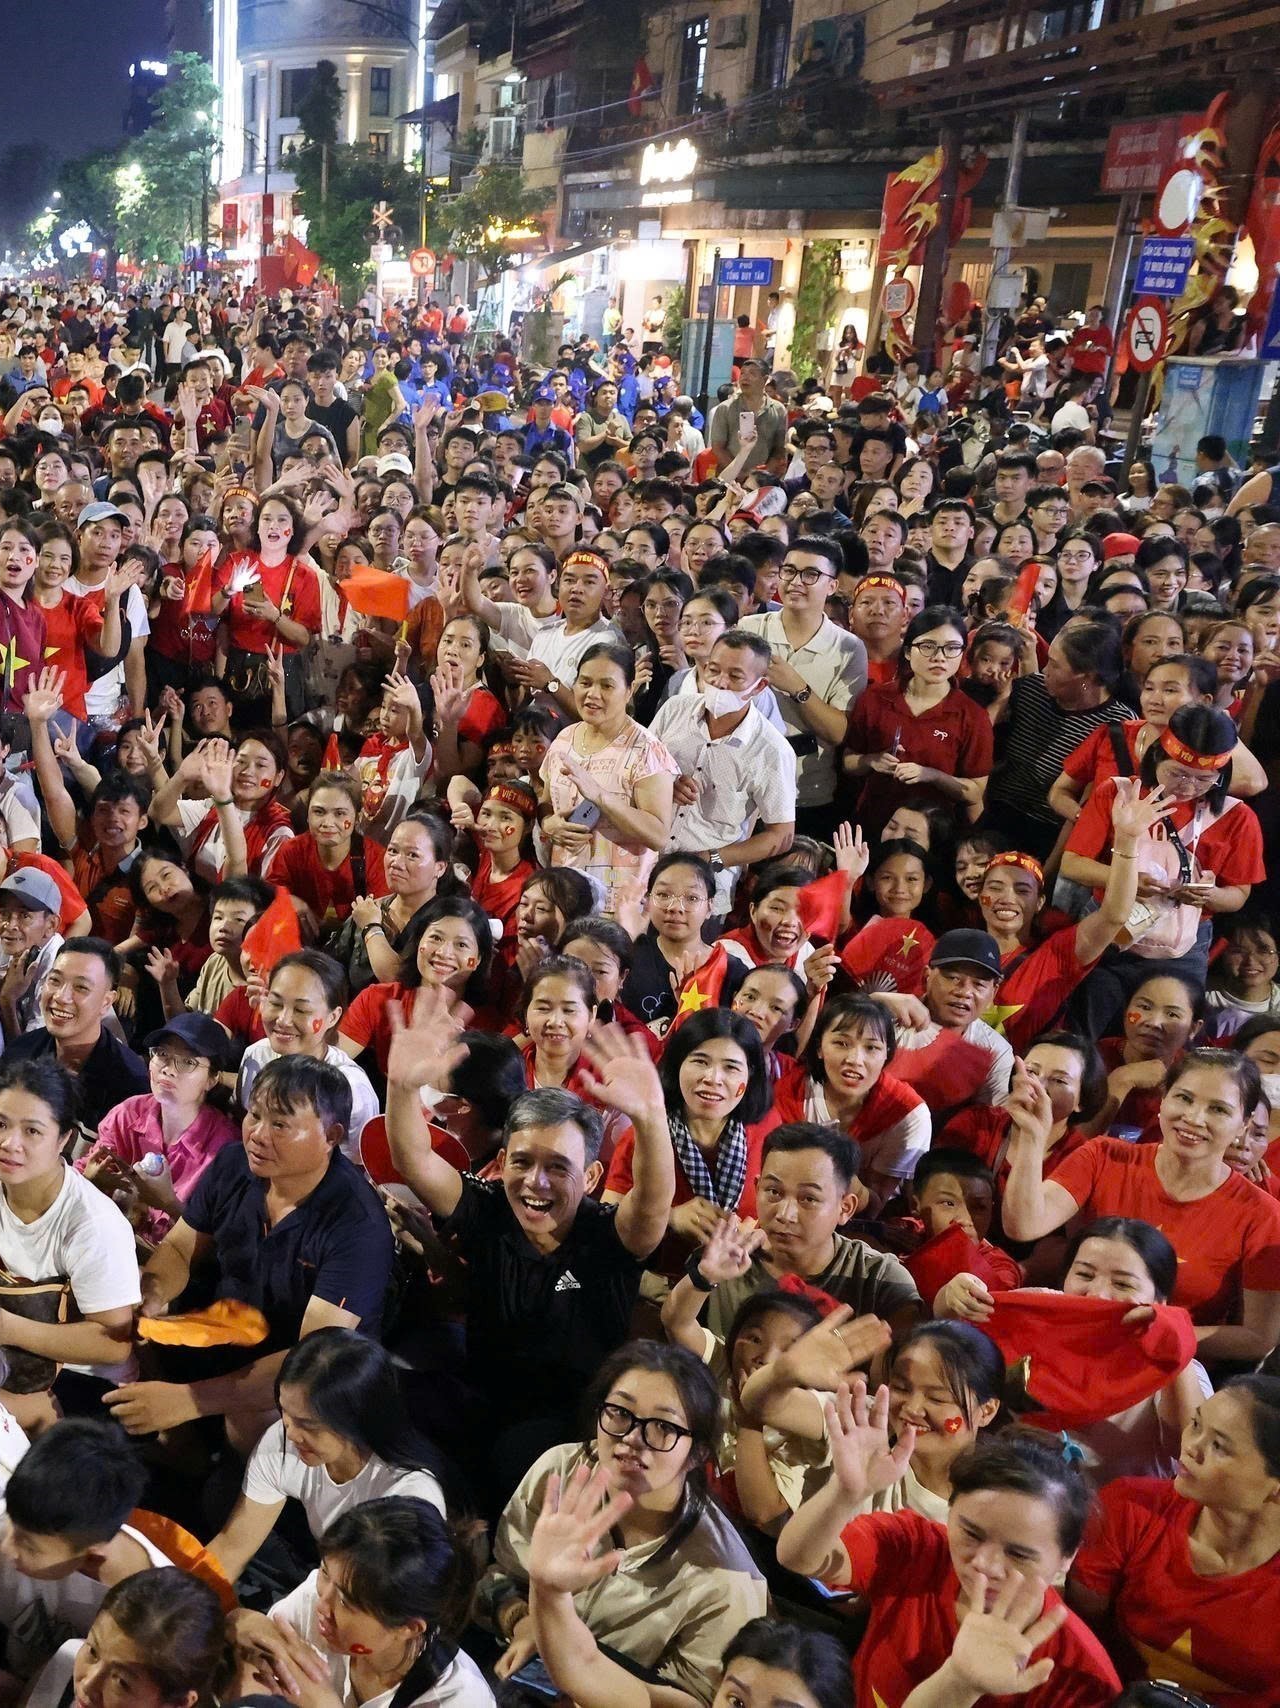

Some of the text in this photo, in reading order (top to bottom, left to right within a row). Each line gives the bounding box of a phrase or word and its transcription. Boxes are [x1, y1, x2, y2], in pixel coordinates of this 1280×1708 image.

[578, 554, 592, 562] YÊU
[881, 577, 894, 588] VIỆT
[1180, 750, 1194, 762] YÊU
[502, 788, 517, 801] VIỆT
[1020, 857, 1035, 872] VIỆT
[555, 1281, 581, 1292] adidas
